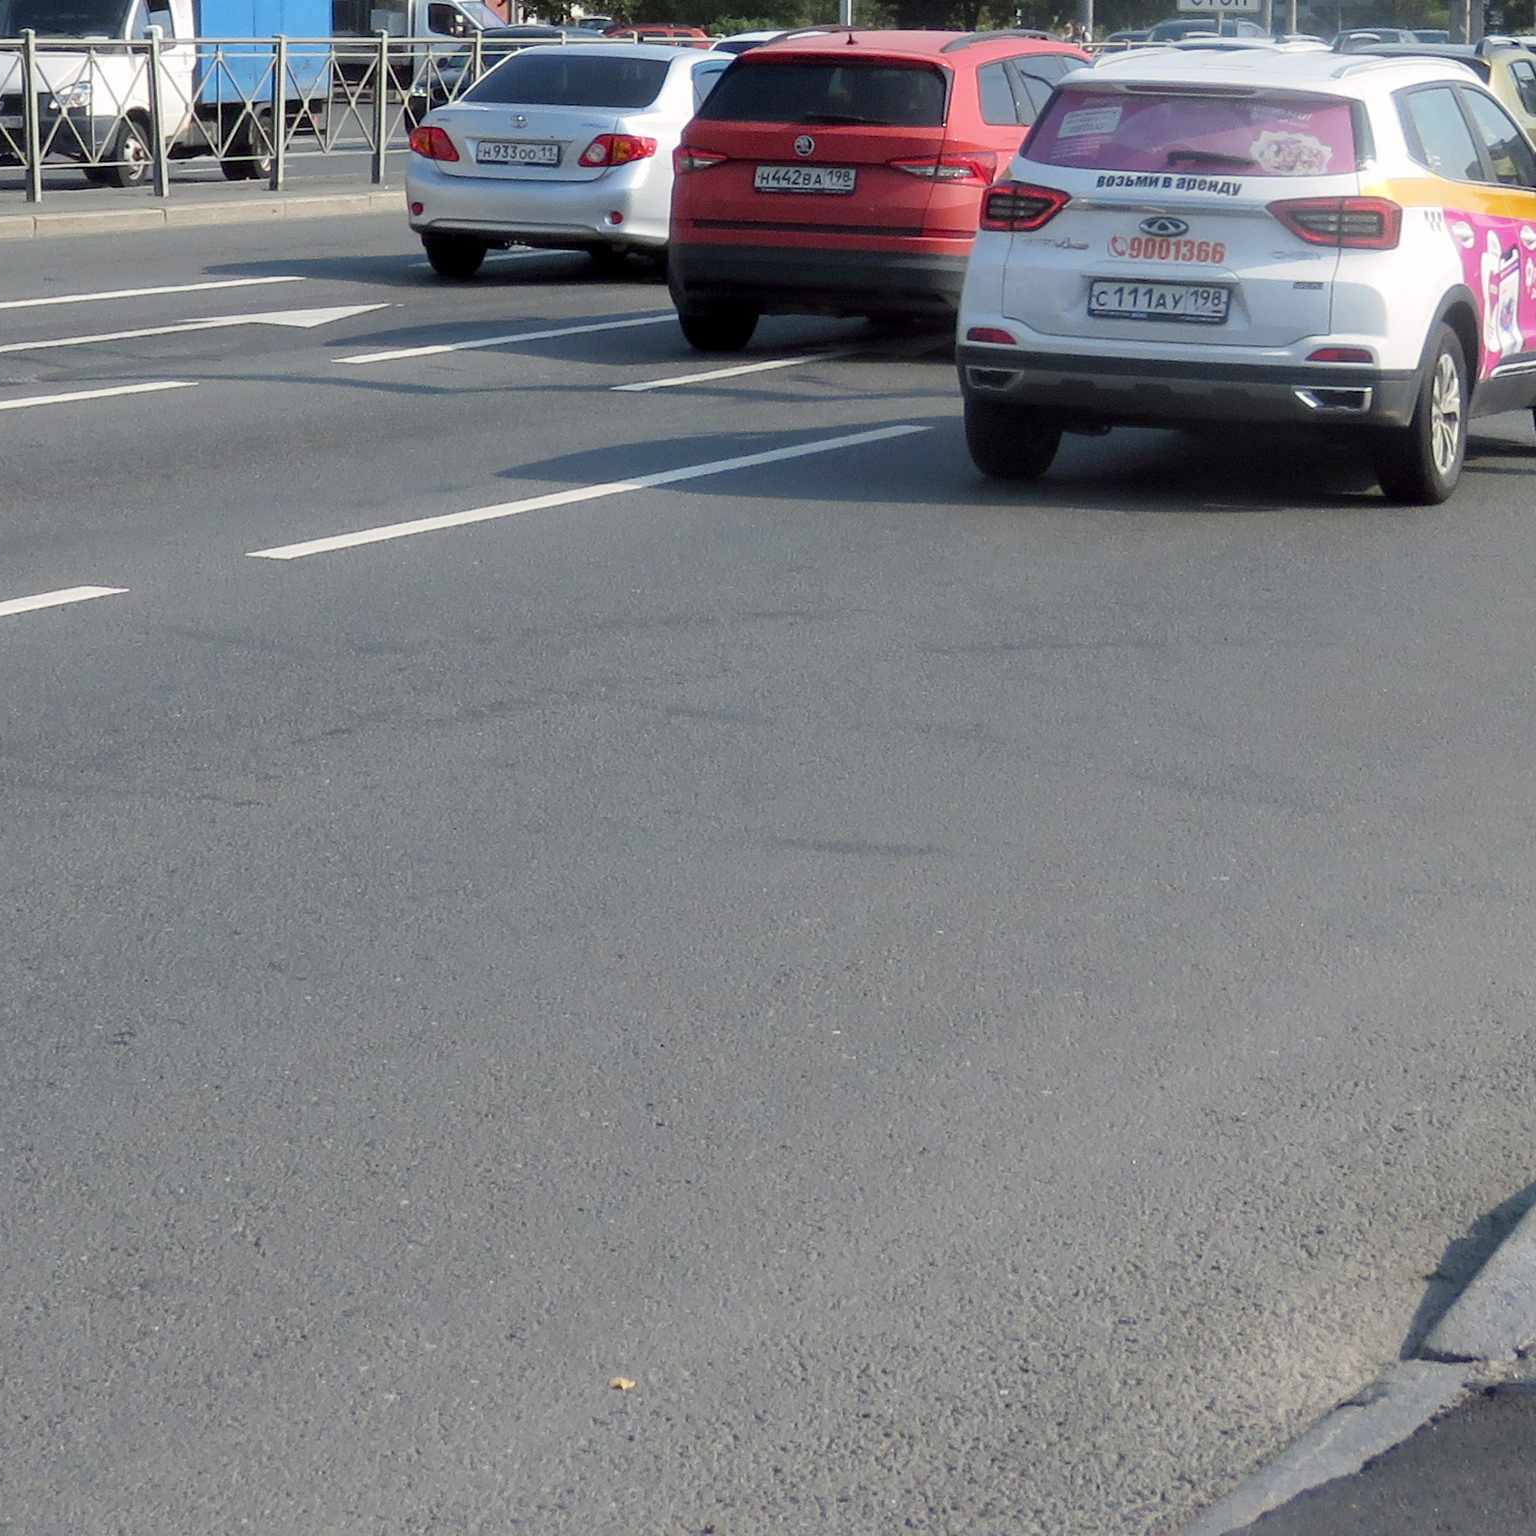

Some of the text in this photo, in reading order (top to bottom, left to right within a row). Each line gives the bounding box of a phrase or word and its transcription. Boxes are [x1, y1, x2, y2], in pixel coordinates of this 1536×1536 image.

[1096, 175, 1242, 196] возьми в аренду
[1129, 236, 1226, 264] 9001366
[1190, 289, 1222, 308] 198
